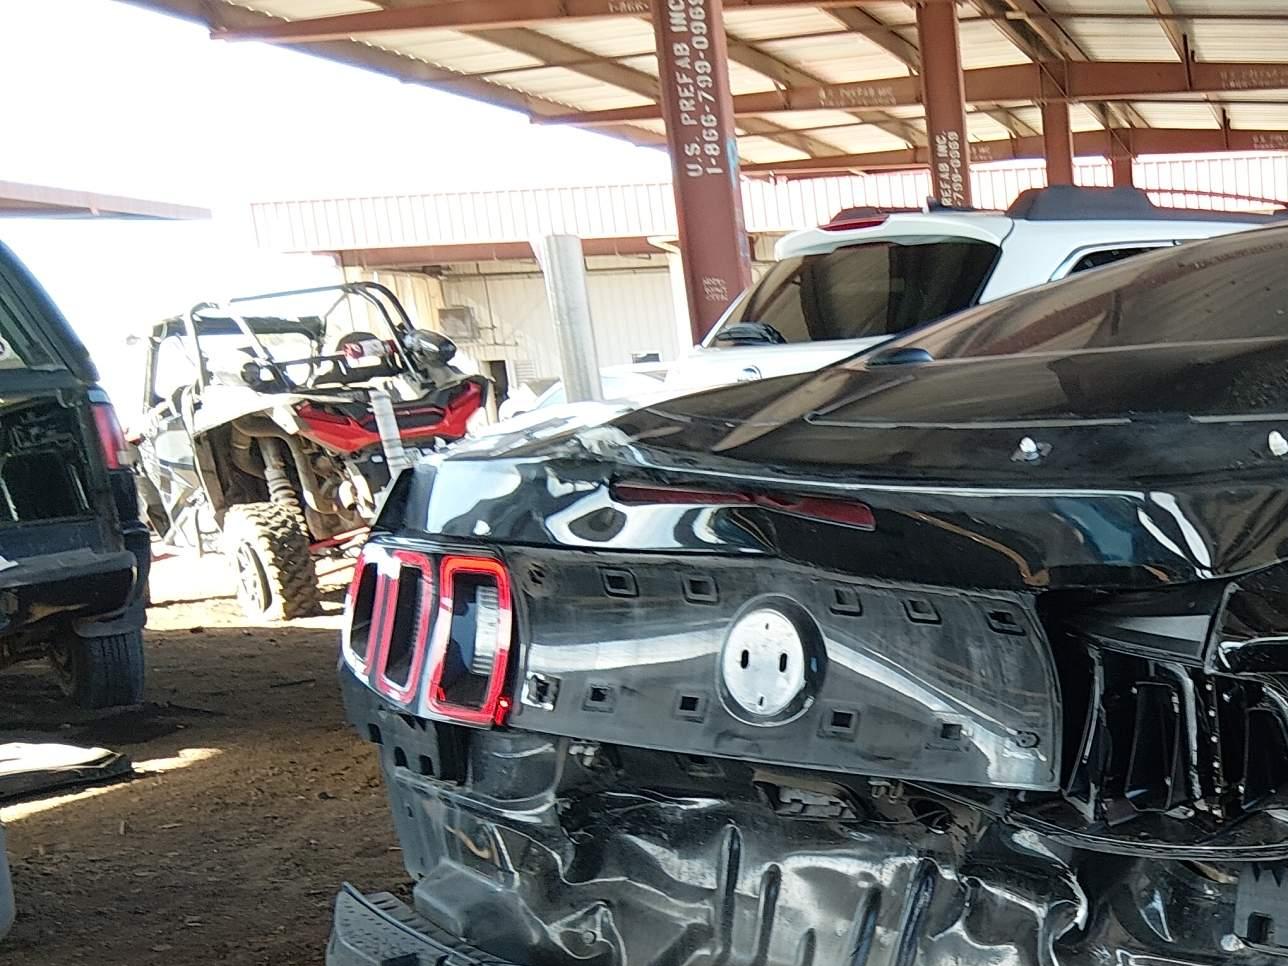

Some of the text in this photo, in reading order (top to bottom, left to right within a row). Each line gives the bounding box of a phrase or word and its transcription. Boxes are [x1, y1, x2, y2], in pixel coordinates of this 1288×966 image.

[672, 42, 698, 126] PREFAB
[938, 162, 953, 206] REFAB
[947, 131, 965, 206] -799-0969
